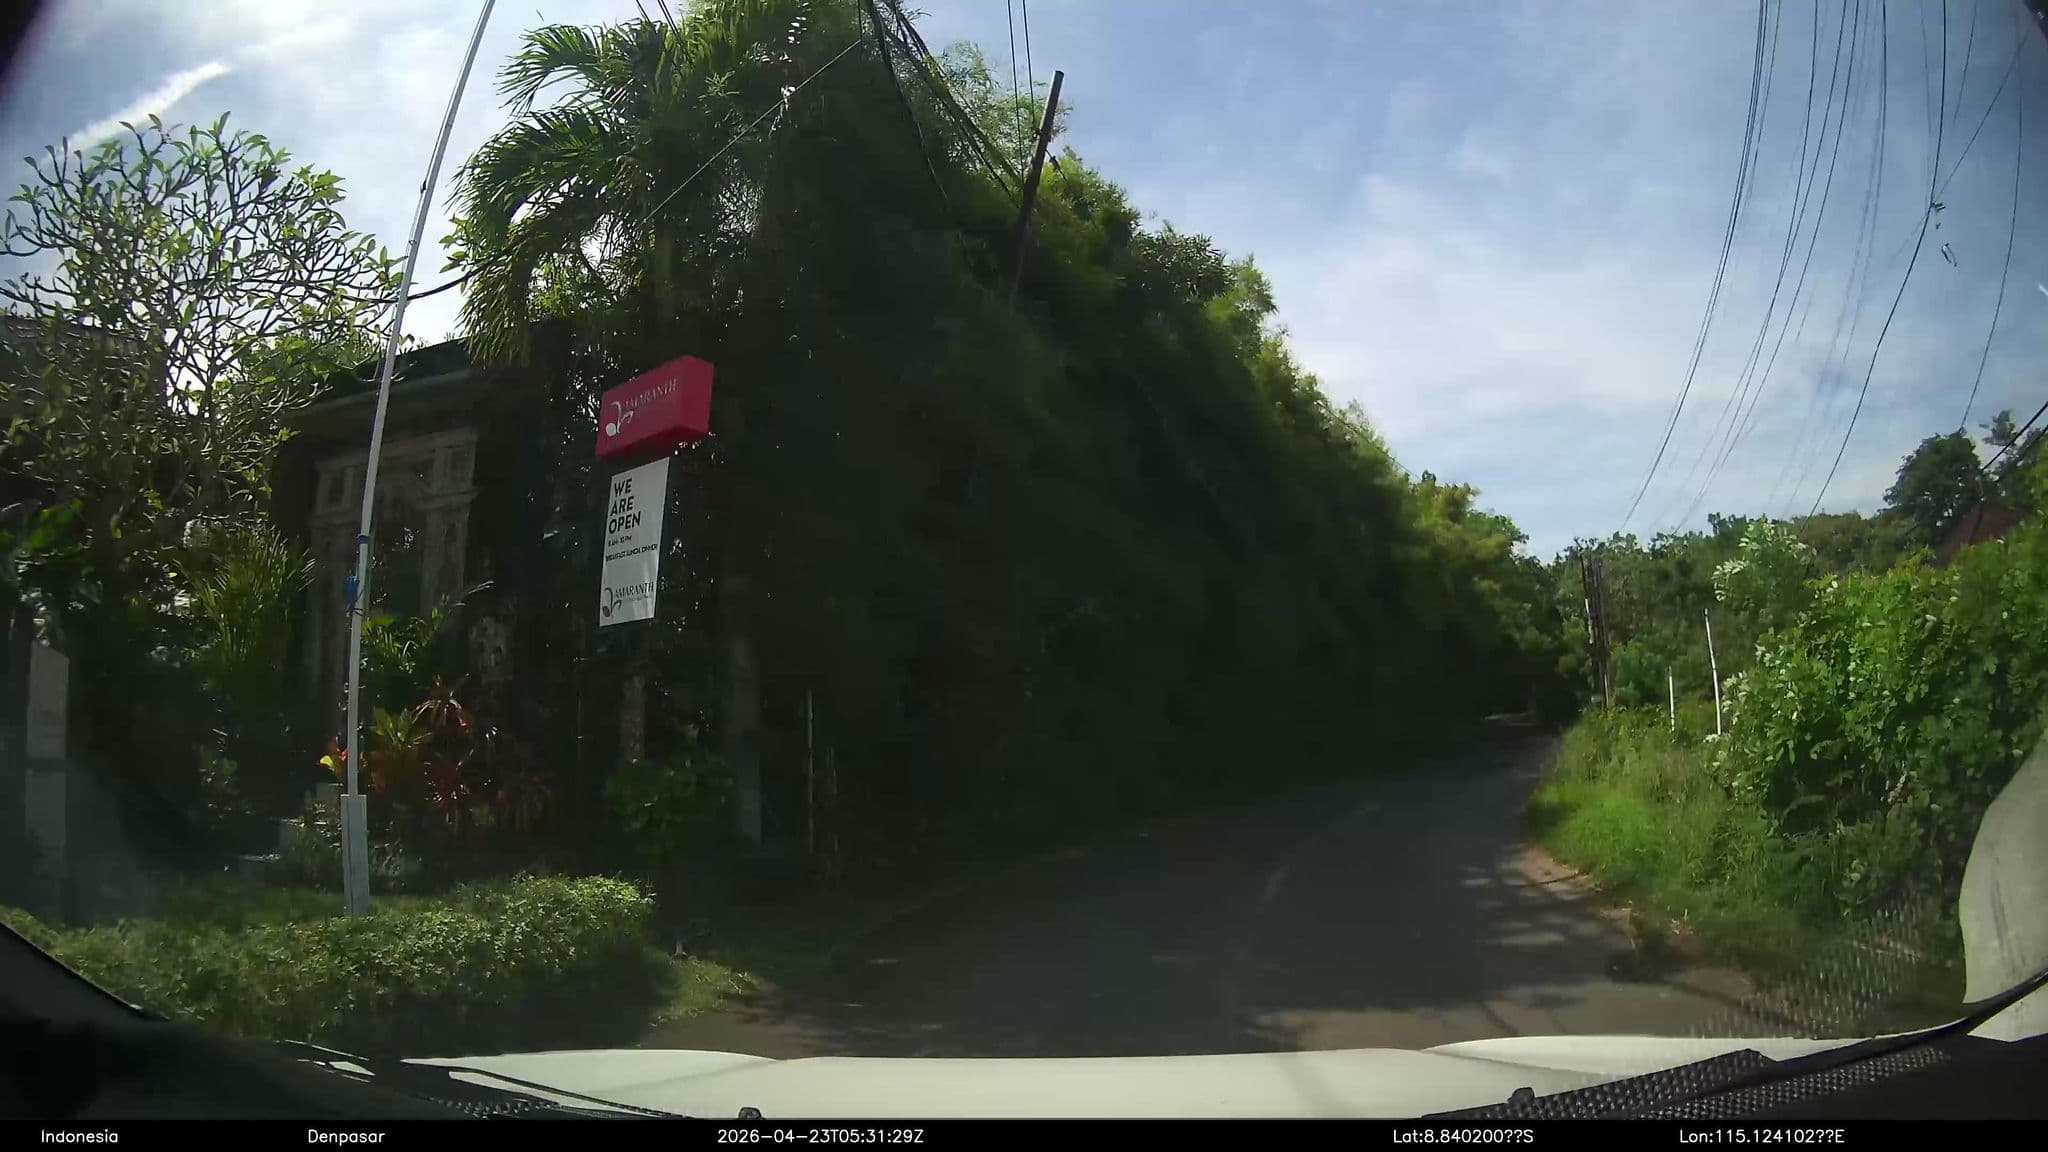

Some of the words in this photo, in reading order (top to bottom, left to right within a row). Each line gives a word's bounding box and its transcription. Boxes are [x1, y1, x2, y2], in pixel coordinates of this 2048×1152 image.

[614, 478, 632, 497] WE
[610, 496, 634, 516] ARE
[608, 511, 641, 534] OPEN
[615, 581, 654, 599] AMARANTH
